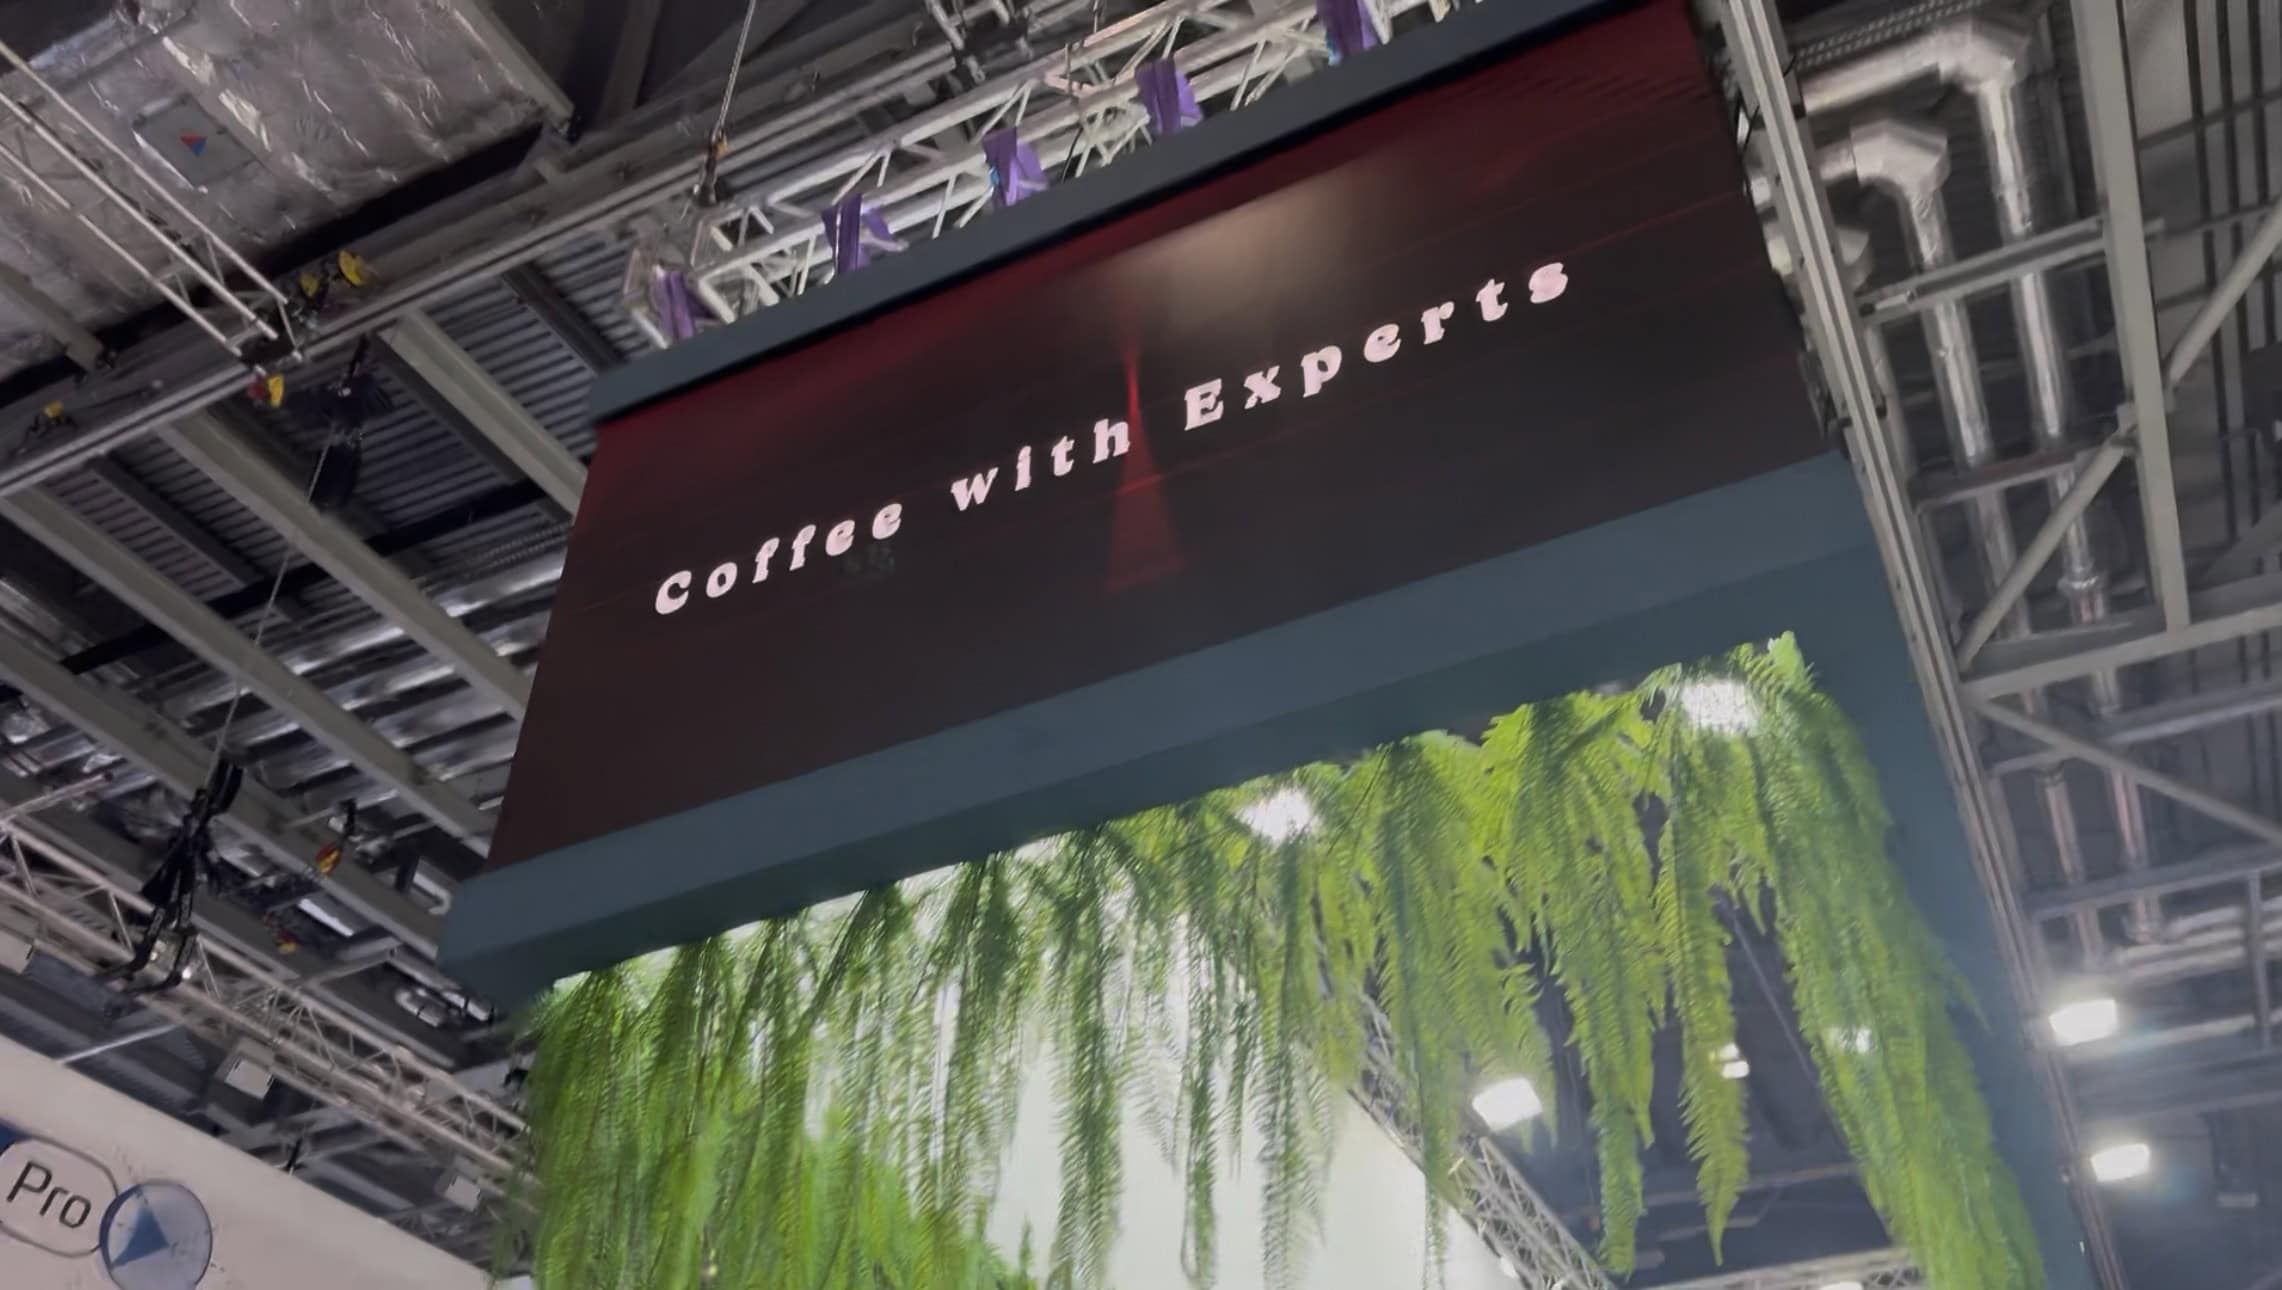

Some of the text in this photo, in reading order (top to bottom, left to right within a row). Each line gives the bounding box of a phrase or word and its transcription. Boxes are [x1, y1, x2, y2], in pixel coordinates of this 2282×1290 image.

[655, 260, 1569, 616] Coffee with Experts
[6, 1160, 92, 1228] Pro
